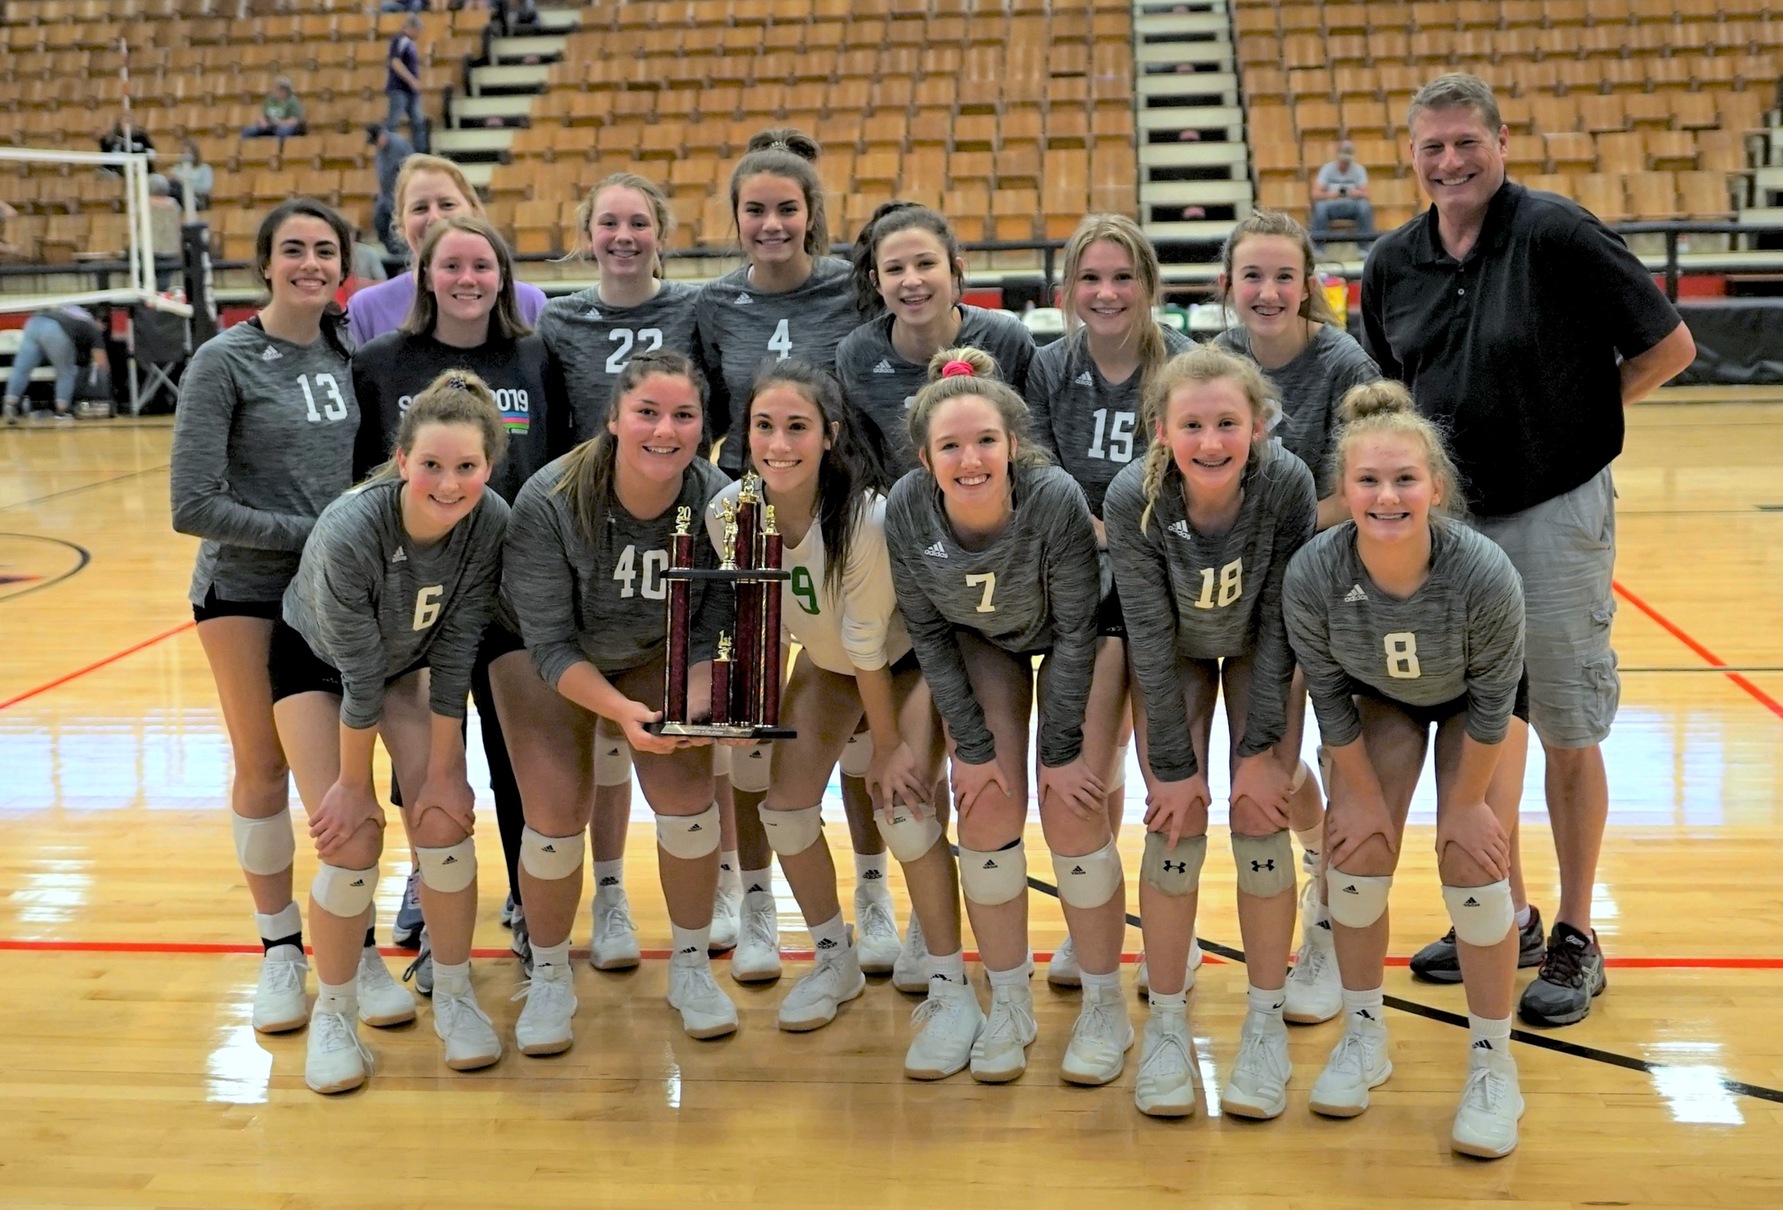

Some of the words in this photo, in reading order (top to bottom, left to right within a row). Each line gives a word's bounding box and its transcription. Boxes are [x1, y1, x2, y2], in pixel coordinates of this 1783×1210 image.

[606, 328, 663, 373] 22
[768, 318, 793, 363] 4
[297, 373, 348, 421] 13
[1088, 408, 1135, 463] 15
[677, 506, 692, 521] 20
[1168, 525, 1191, 540] adidas
[613, 545, 669, 600] 40
[924, 549, 949, 559] adidas
[791, 566, 821, 615] 9
[965, 571, 996, 613] 7
[1194, 557, 1243, 608] 18
[413, 584, 443, 632] 6
[1384, 632, 1422, 679] 8
